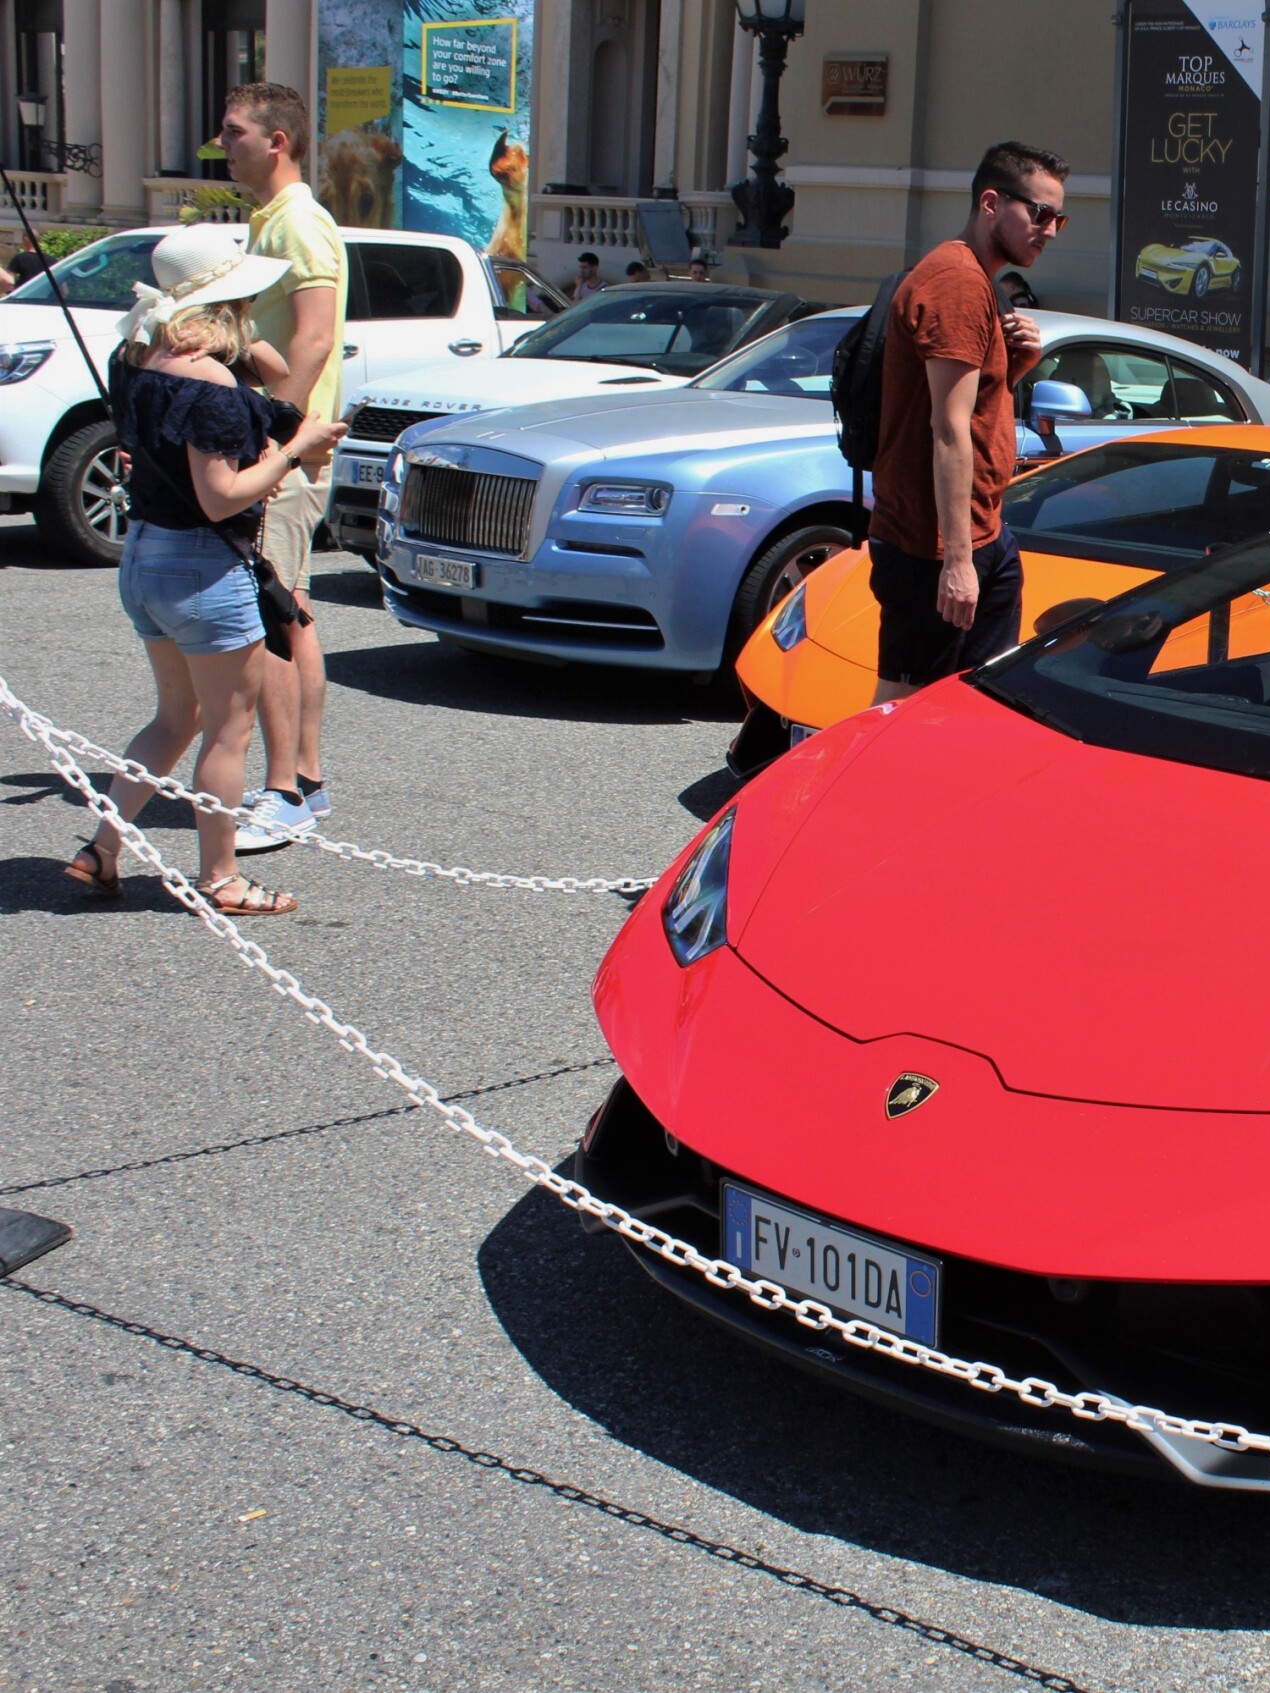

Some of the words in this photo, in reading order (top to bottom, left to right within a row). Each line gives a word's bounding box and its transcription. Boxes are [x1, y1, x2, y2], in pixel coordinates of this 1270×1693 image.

[1217, 20, 1256, 29] BARCLAYS
[432, 36, 451, 47] How
[453, 39, 465, 50] far
[467, 41, 496, 54] beyond
[432, 50, 452, 59] your
[453, 52, 486, 64] comfort
[487, 58, 507, 67] zone
[1179, 56, 1213, 72] TOP
[432, 61, 446, 70] are
[448, 64, 464, 73] you
[465, 65, 491, 78] willing
[432, 72, 441, 81] to
[443, 75, 458, 85] go?
[1165, 72, 1225, 86] MARQUES
[1168, 112, 1218, 137] GET
[1151, 138, 1233, 163] LUCKY
[1161, 200, 1173, 211] LE
[1174, 201, 1218, 212] CASINO
[1130, 306, 1198, 324] SUPERCAR
[1200, 311, 1242, 326] SHOW
[1215, 349, 1240, 358] now
[421, 401, 482, 411] ROVER
